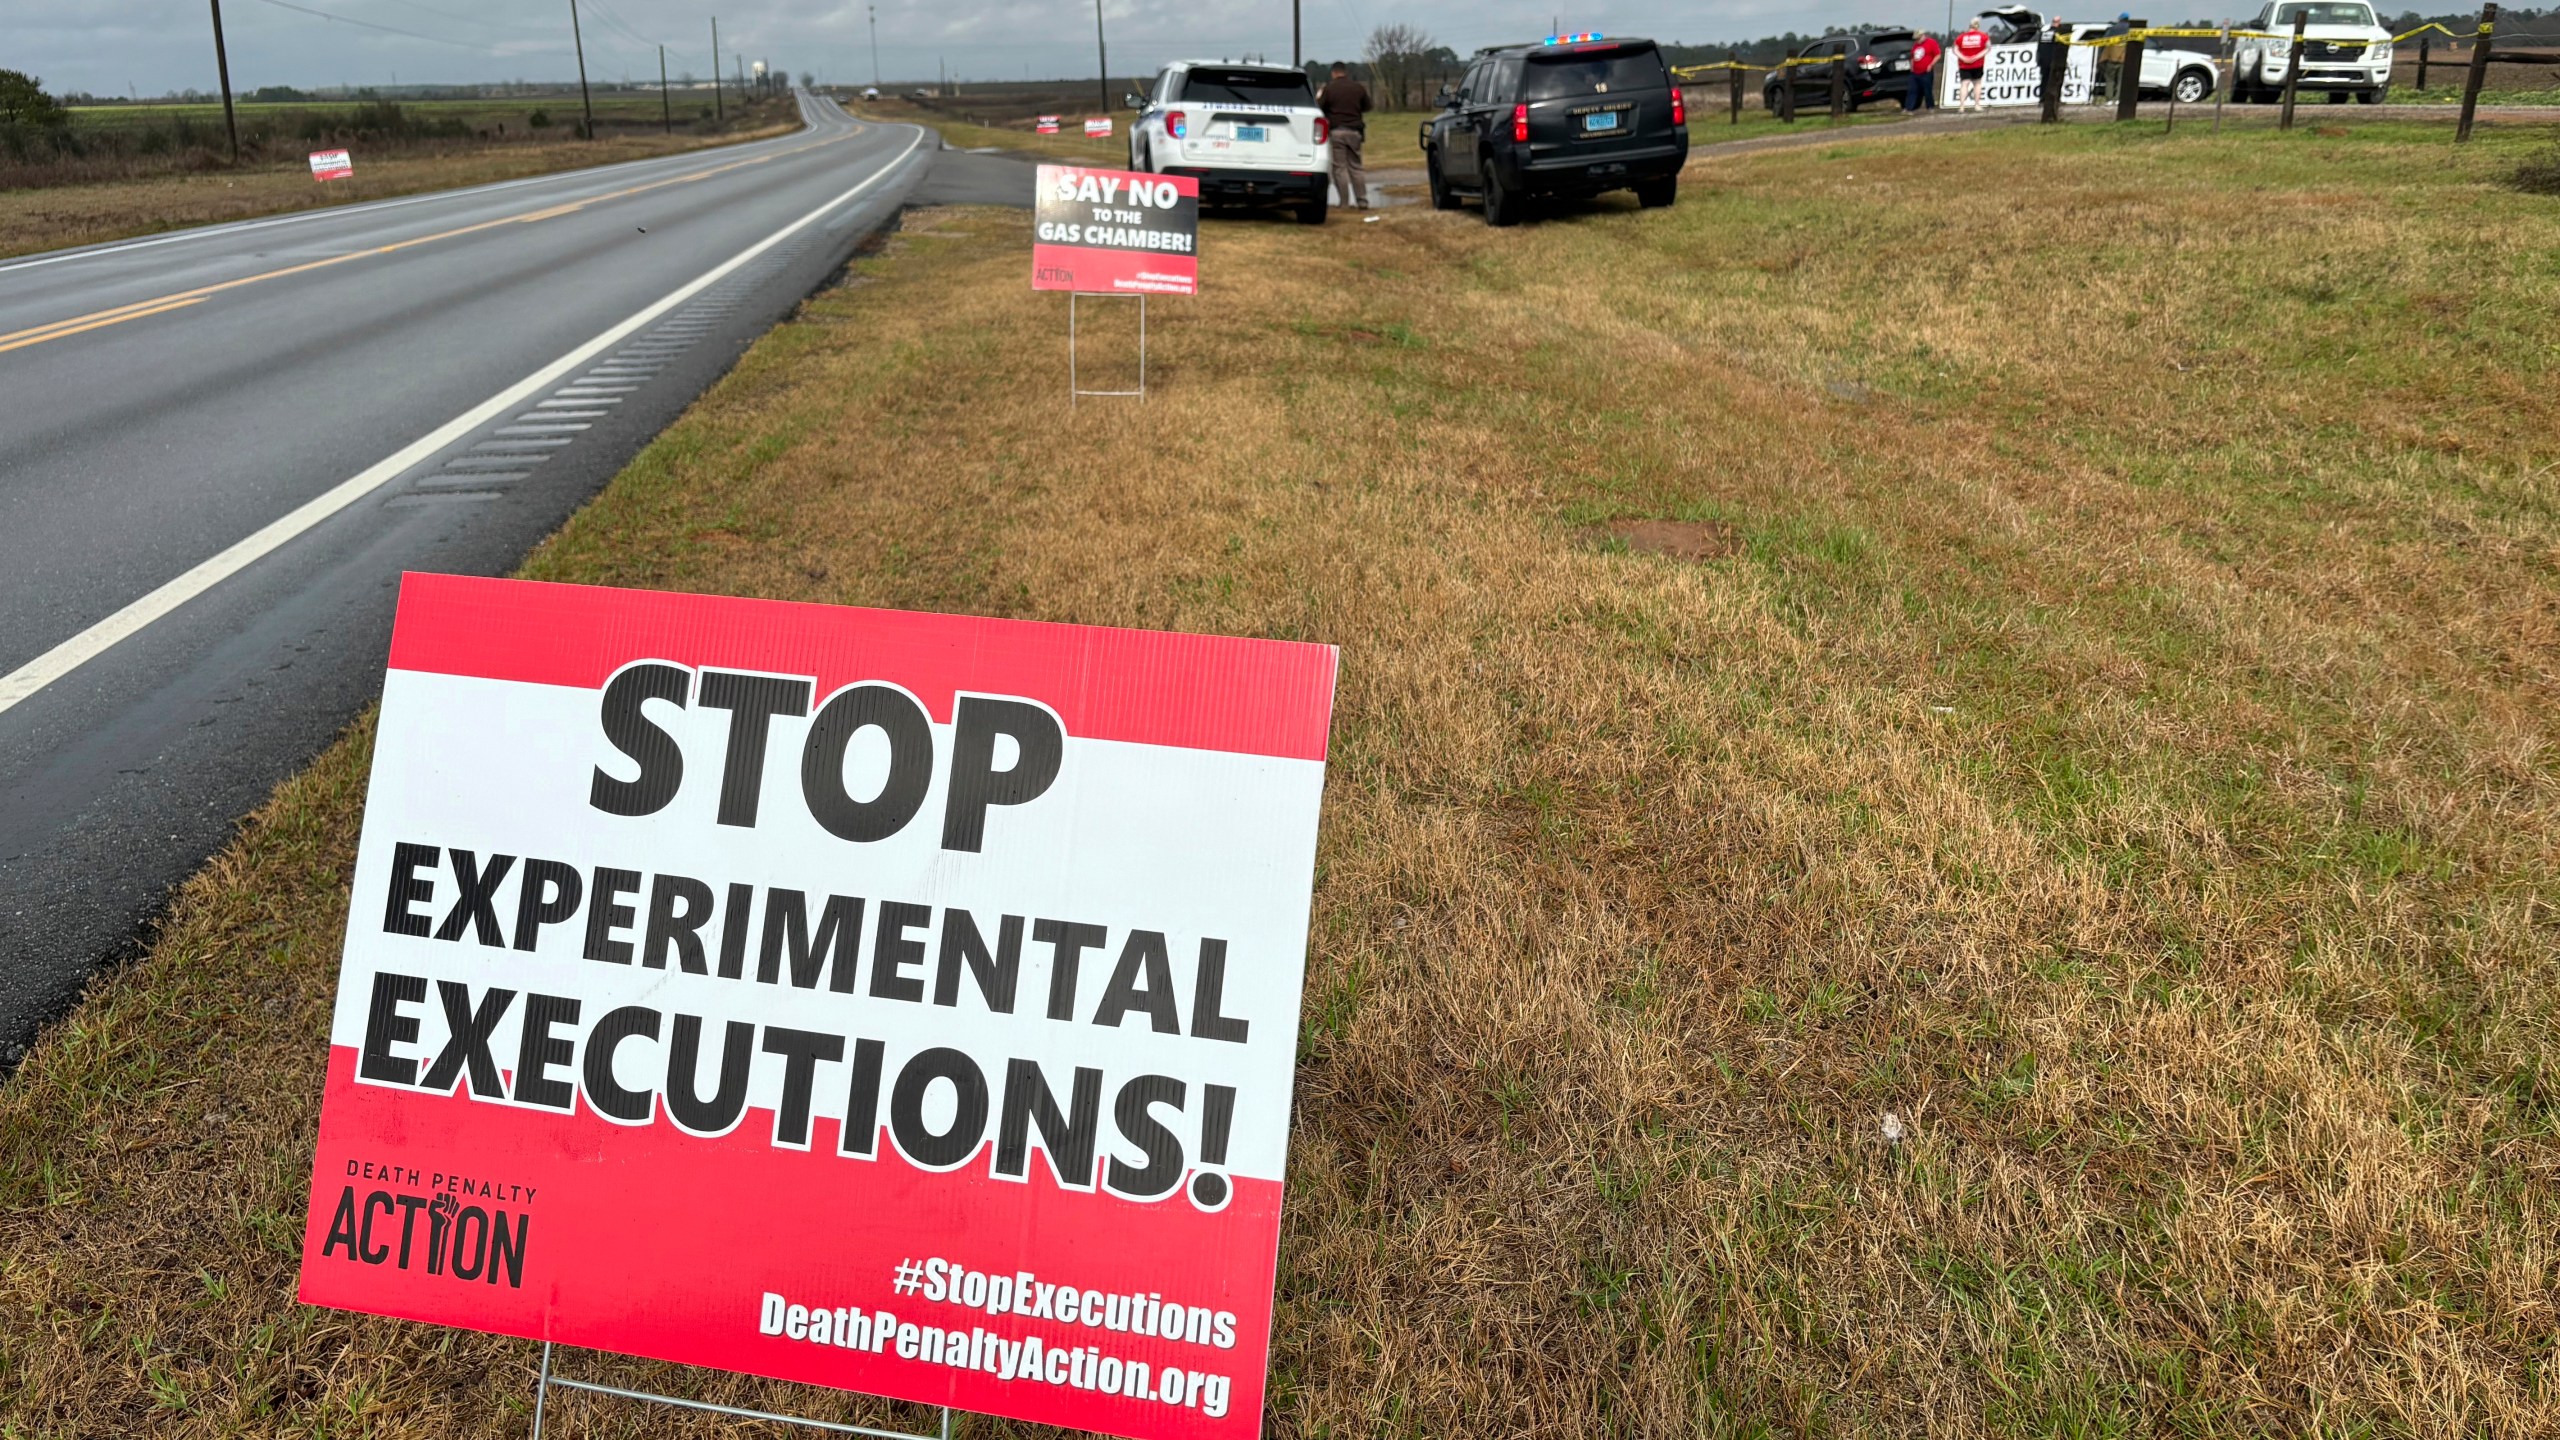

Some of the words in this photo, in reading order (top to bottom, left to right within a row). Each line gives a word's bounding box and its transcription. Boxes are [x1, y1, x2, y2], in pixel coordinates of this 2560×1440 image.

[1955, 64, 2081, 84] EERIMEAL
[1996, 50, 2033, 65] STO
[1594, 82, 1608, 93] 18
[1058, 173, 1120, 204] SAY
[1129, 179, 1178, 209] NO
[1038, 222, 1080, 242] GAS
[1084, 226, 1192, 252] CHAMBER!
[1092, 208, 1112, 222] TO
[1113, 209, 1142, 225] THE
[589, 662, 1063, 853] STOP
[382, 842, 1249, 1044] EXPERIMENTAL
[359, 971, 1237, 1206] EXECUTIONS!
[346, 1159, 420, 1187] DEATH
[431, 1173, 537, 1205] PENALTY
[322, 1186, 530, 1289] ACTION
[893, 1257, 1238, 1349] #StopExecutions
[759, 1291, 1232, 1418] DeathPenaltyAction.org
